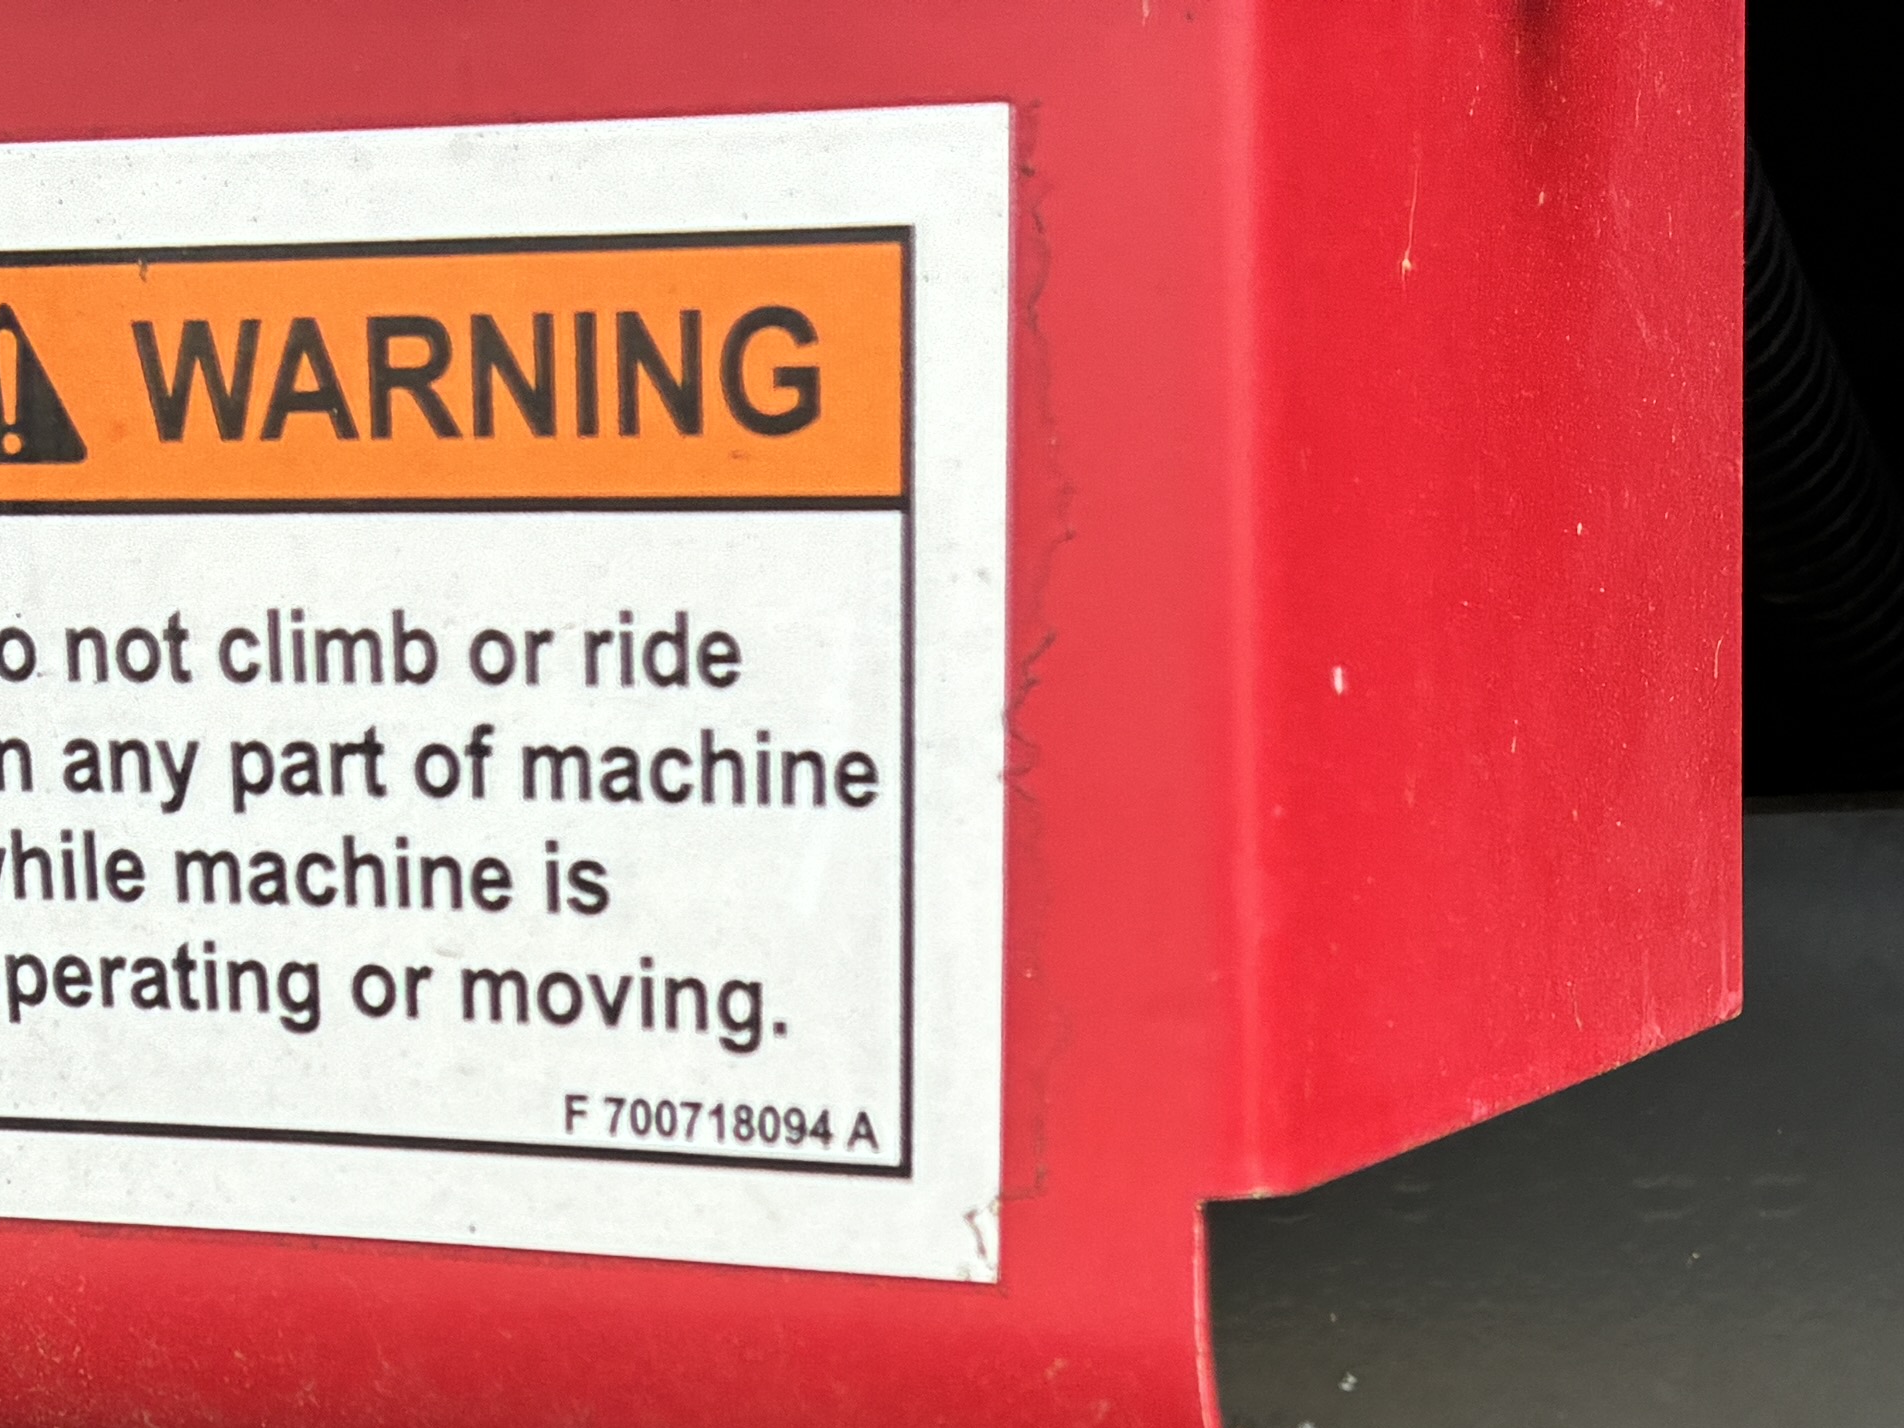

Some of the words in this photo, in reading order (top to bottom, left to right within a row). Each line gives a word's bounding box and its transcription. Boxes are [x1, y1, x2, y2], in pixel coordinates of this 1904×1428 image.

[131, 304, 822, 442] WARNING
[65, 612, 193, 684] not
[218, 609, 439, 686] climb
[468, 625, 553, 686] or
[583, 611, 742, 689] ride
[63, 736, 198, 812] any
[230, 729, 385, 812] part
[413, 725, 495, 798] of
[521, 730, 880, 808] machine
[174, 836, 513, 914] machine
[544, 841, 610, 914] is
[350, 962, 433, 1019] or
[460, 958, 787, 1052] moving.
[564, 1095, 589, 1133] F
[603, 1096, 833, 1149] 700718094
[846, 1112, 879, 1151] A
